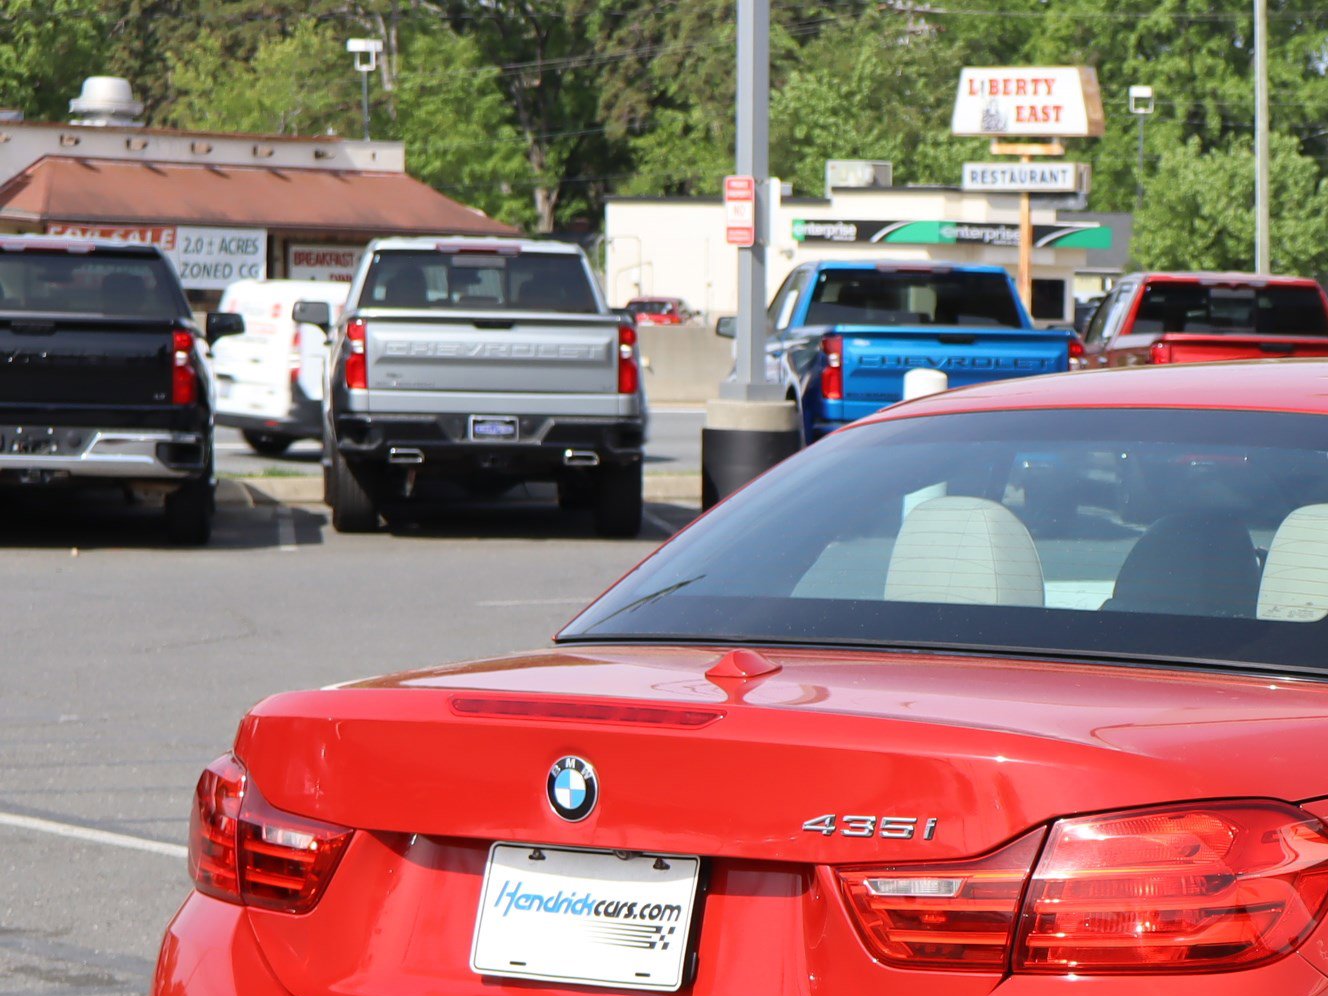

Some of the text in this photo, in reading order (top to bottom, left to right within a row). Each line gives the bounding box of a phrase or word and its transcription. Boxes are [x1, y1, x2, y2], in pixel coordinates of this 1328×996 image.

[968, 78, 1056, 97] LIBERTY
[1015, 105, 1064, 123] EAST
[970, 169, 1068, 184] RESTAURANT
[183, 237, 203, 254] 2.0
[219, 237, 259, 254] ACRES
[293, 251, 354, 267] BREAKFAST
[180, 262, 232, 280] ZONED
[385, 341, 602, 359] CHEVROLET
[858, 355, 1056, 371] CHEVROLET
[551, 757, 593, 780] BMW
[802, 813, 938, 841] 435i
[493, 880, 682, 922] Hendrickcars.com
